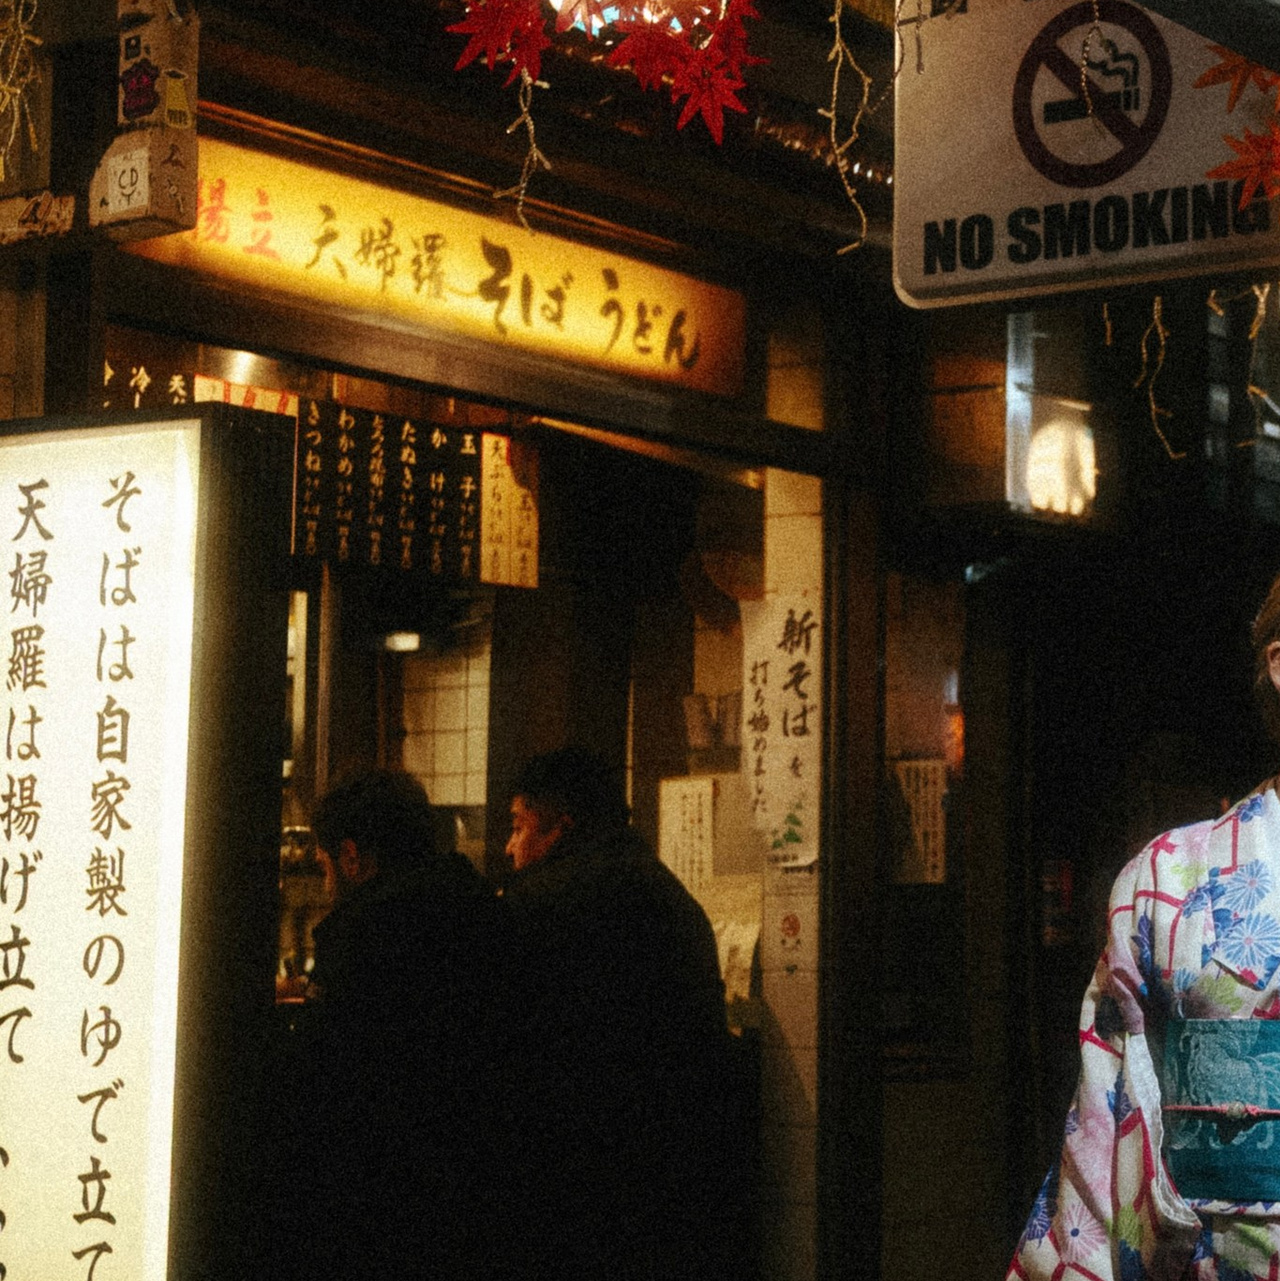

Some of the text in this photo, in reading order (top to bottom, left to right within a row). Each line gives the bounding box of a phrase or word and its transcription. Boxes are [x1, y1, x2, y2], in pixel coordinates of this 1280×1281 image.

[922, 180, 1272, 276] NO SMOKING
[478, 234, 574, 340] そば
[599, 268, 701, 371] うどん
